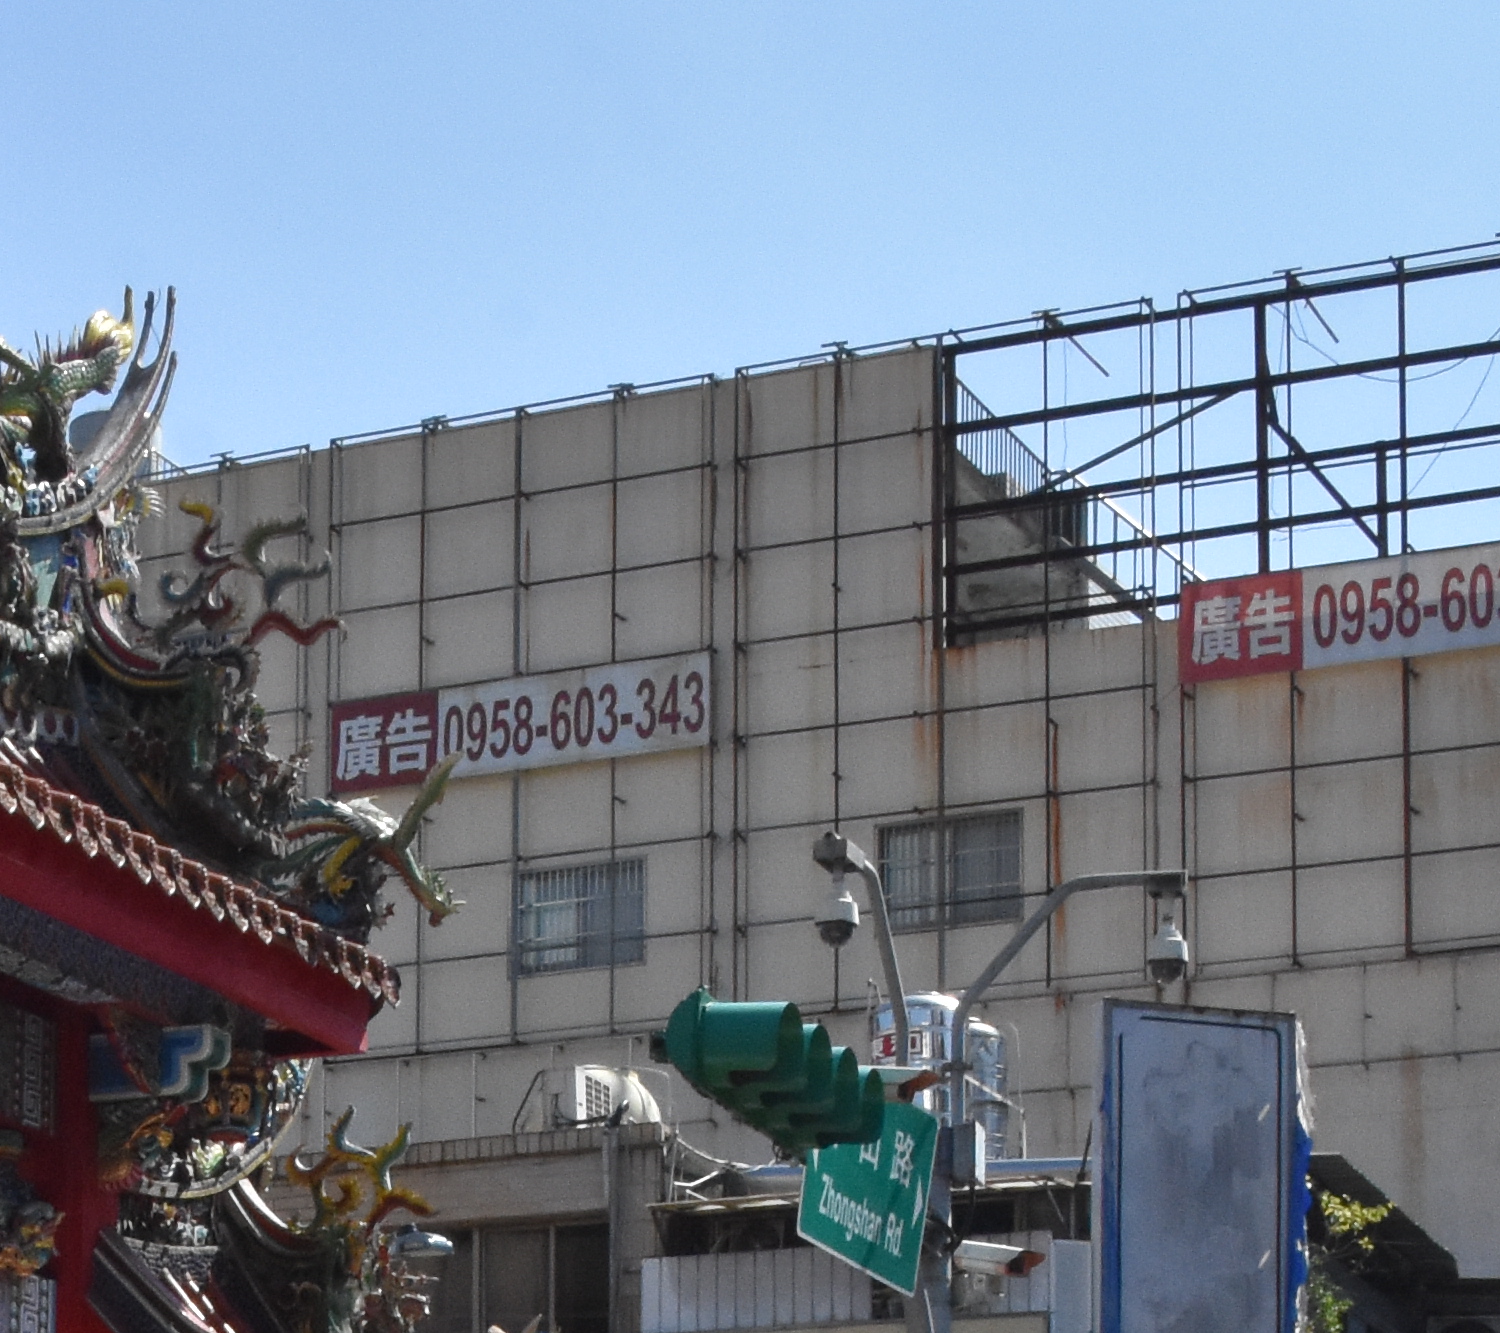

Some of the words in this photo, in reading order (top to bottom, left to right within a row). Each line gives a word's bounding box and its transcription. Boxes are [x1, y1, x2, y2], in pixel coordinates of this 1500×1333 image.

[1190, 588, 1295, 665] 廣告
[336, 709, 431, 781] 廣告
[443, 670, 705, 762] 0958-603-343
[818, 1172, 882, 1246] Zhongshan
